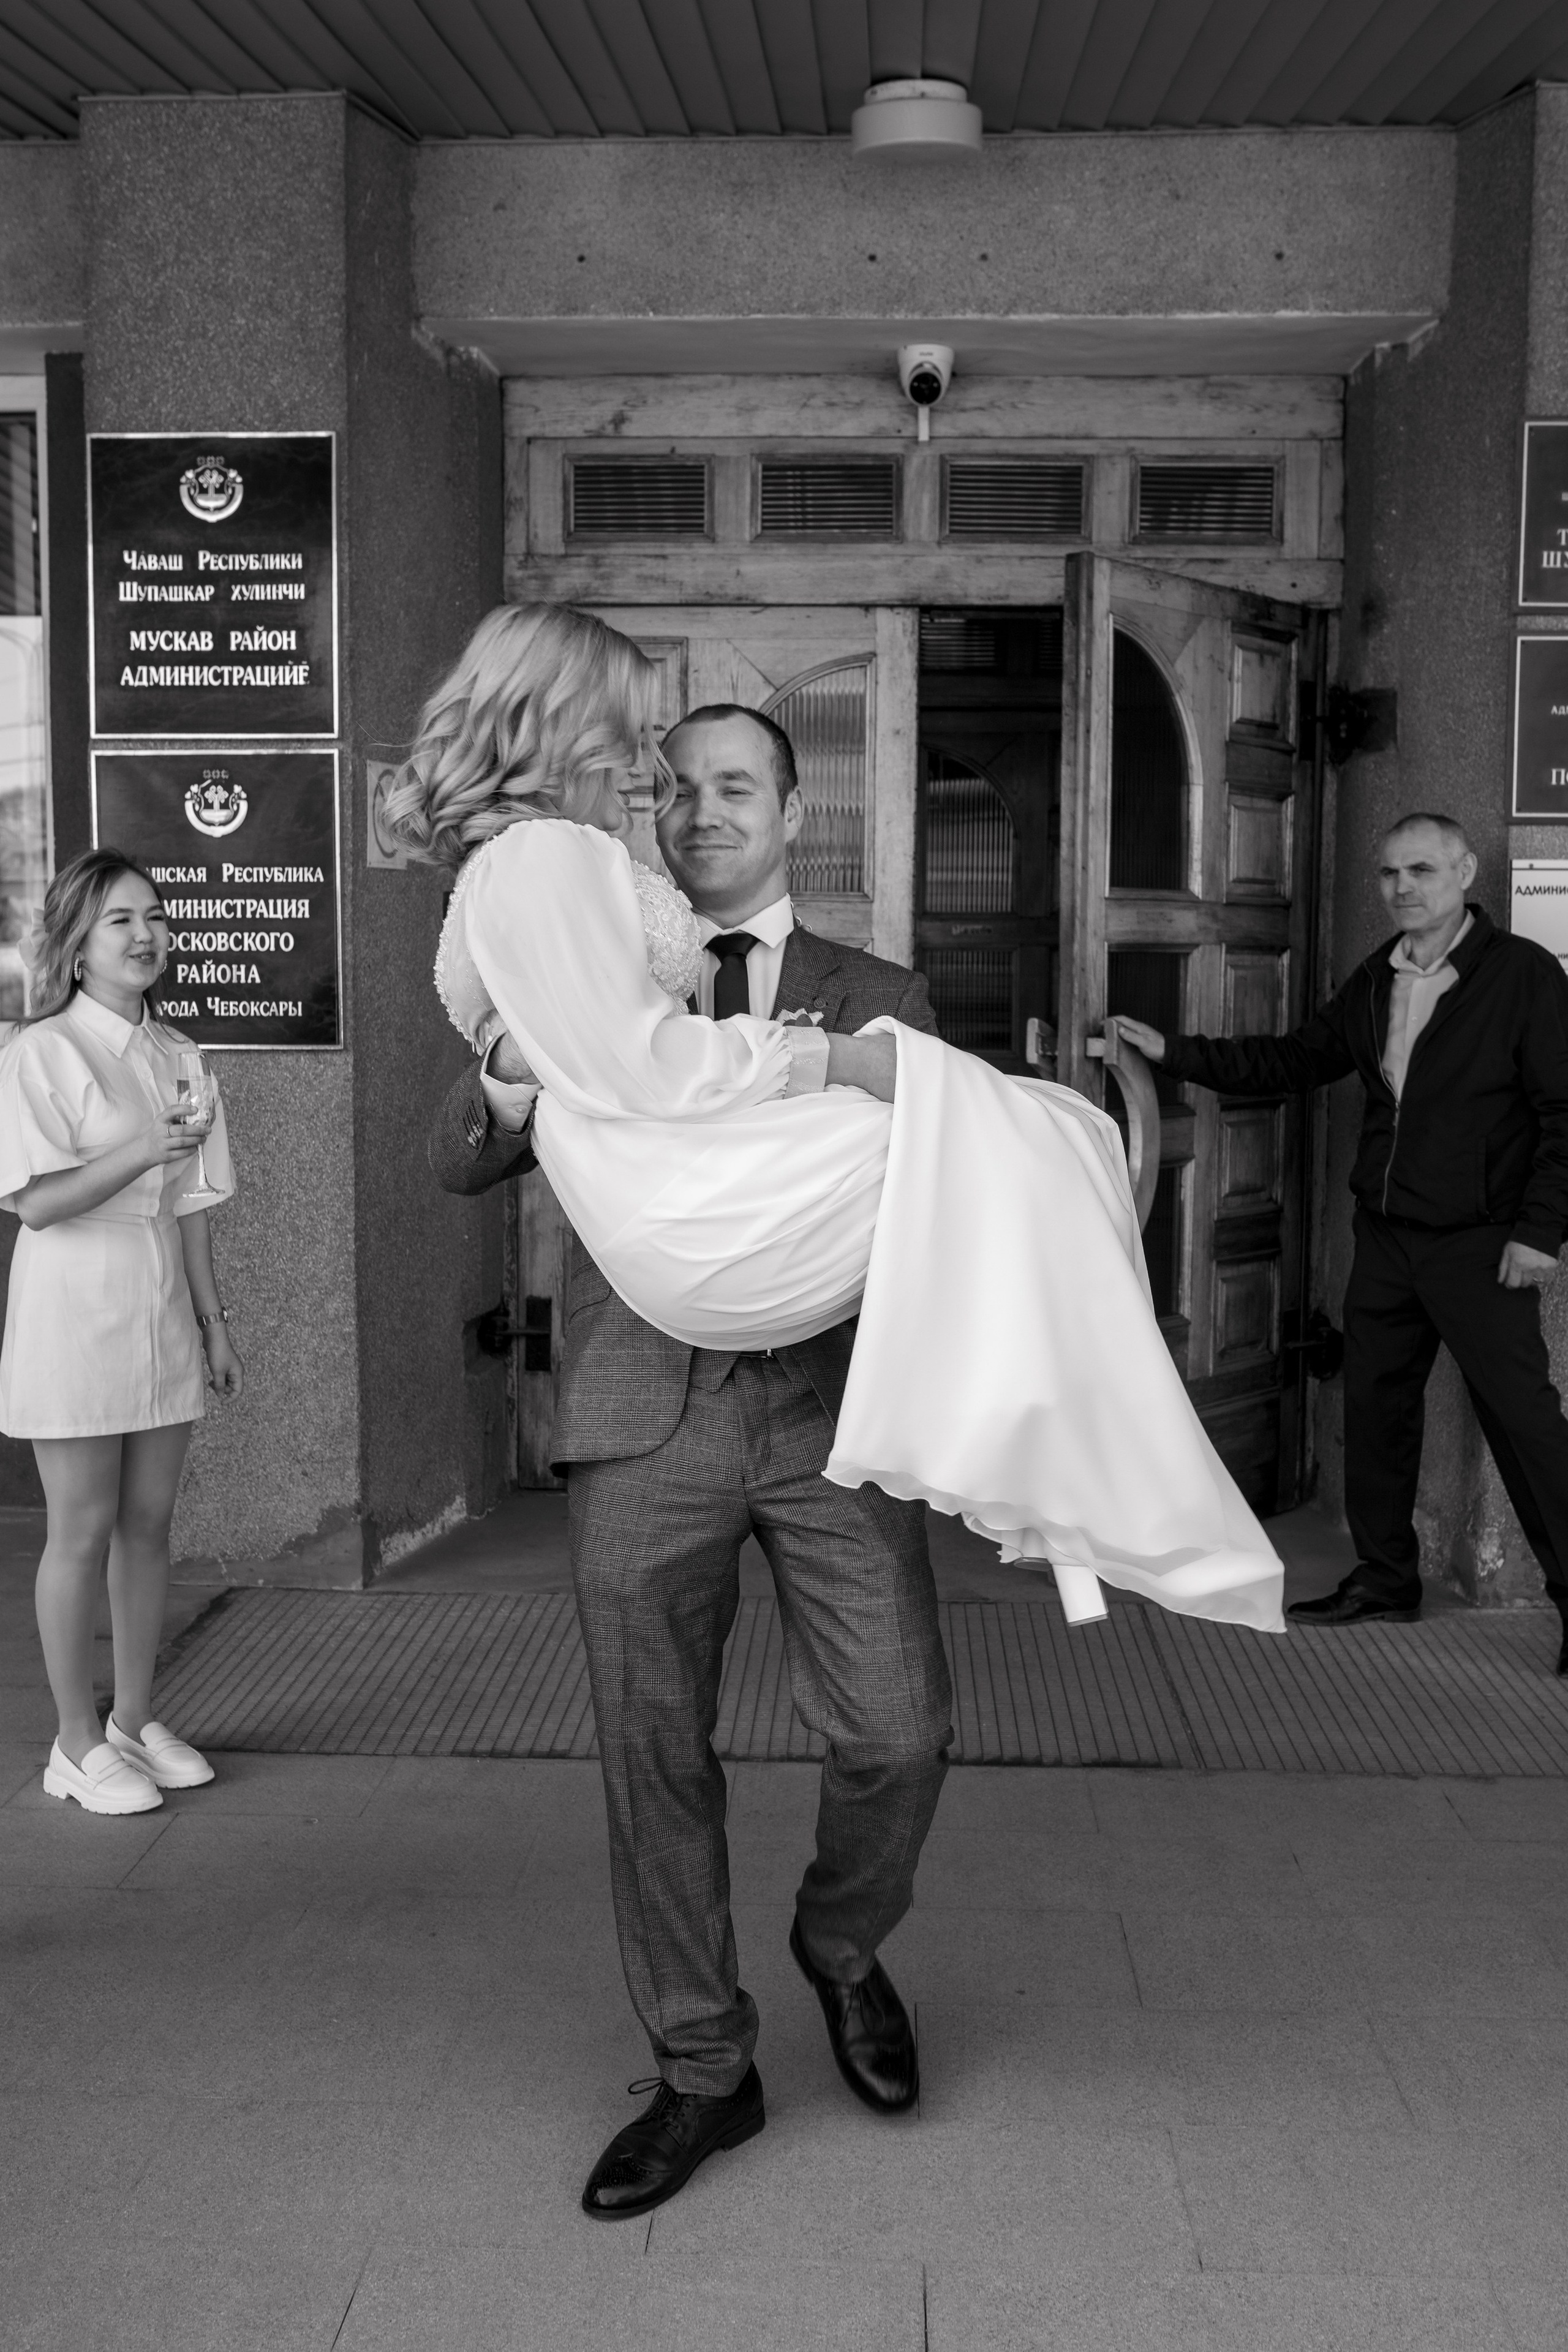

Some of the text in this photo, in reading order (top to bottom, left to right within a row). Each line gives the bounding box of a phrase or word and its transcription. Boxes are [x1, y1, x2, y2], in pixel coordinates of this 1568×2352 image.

[118, 581, 215, 602] ШУПАШКАР
[129, 625, 297, 652] МУСКАВ РАЙОН
[146, 862, 324, 883] ШСКАЯ РЕСПУБЛИКА
[1515, 886, 1568, 896] АДМИНИ
[163, 899, 310, 920] МИНИСТРАЦИЯ
[167, 932, 295, 952] ОСКОВСКОГО
[176, 959, 261, 984] РАЙОНА
[157, 1000, 199, 1017] РОДА
